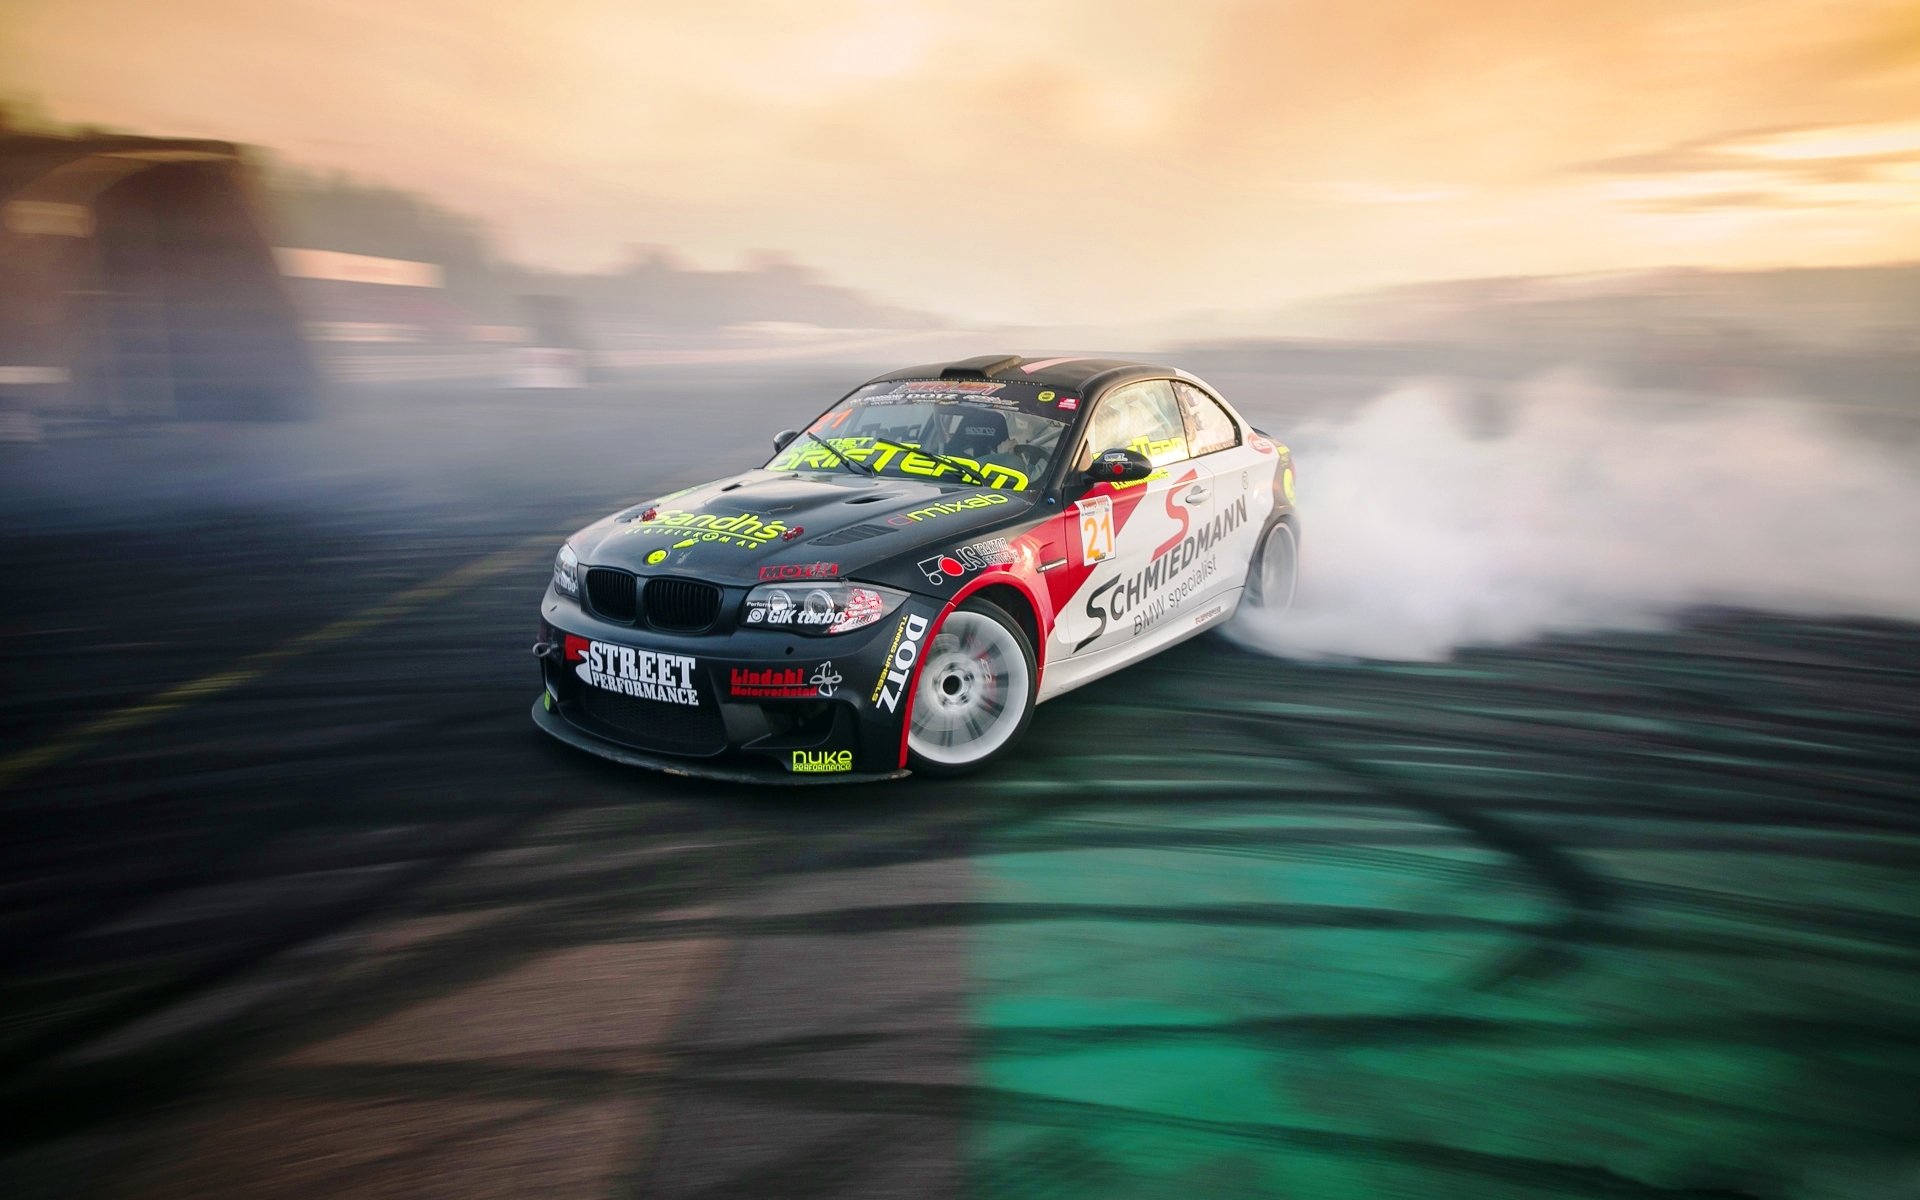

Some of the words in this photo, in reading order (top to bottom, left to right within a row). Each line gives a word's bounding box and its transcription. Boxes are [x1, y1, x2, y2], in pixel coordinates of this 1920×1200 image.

[965, 426, 996, 435] sparco
[1083, 511, 1113, 559] 21
[1133, 595, 1165, 636] BMW
[1168, 554, 1217, 609] specialist
[797, 606, 848, 625] turbo
[890, 615, 908, 653] TUNING
[589, 640, 696, 689] STREET
[730, 667, 805, 685] Lindahl
[872, 654, 894, 702] WHEELS
[876, 613, 928, 714] DOTZ
[592, 671, 700, 706] PERFORMANCE
[792, 750, 853, 764] nuke
